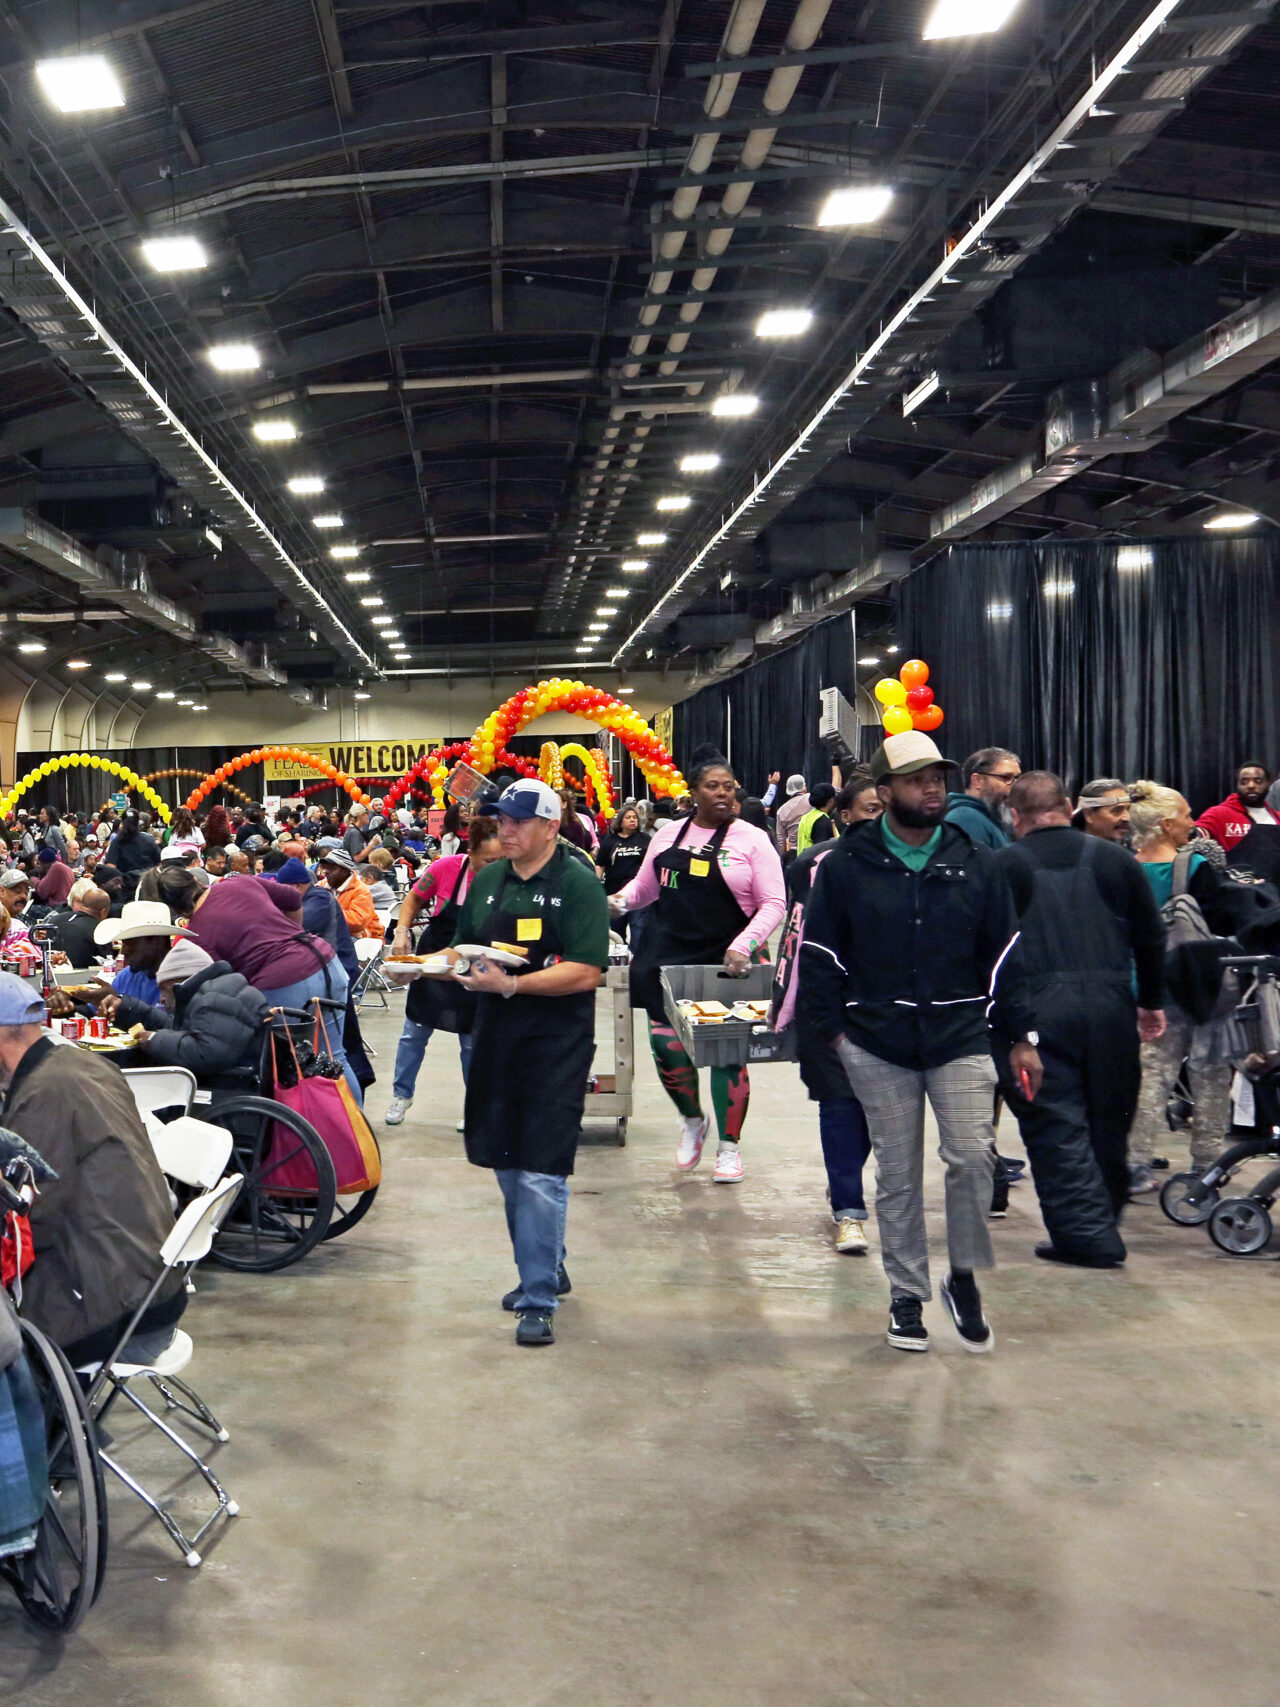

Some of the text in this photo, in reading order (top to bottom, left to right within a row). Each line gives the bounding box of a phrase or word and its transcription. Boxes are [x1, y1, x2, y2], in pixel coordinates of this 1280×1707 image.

[272, 769, 322, 778] OF SHARING
[660, 867, 680, 889] MK
